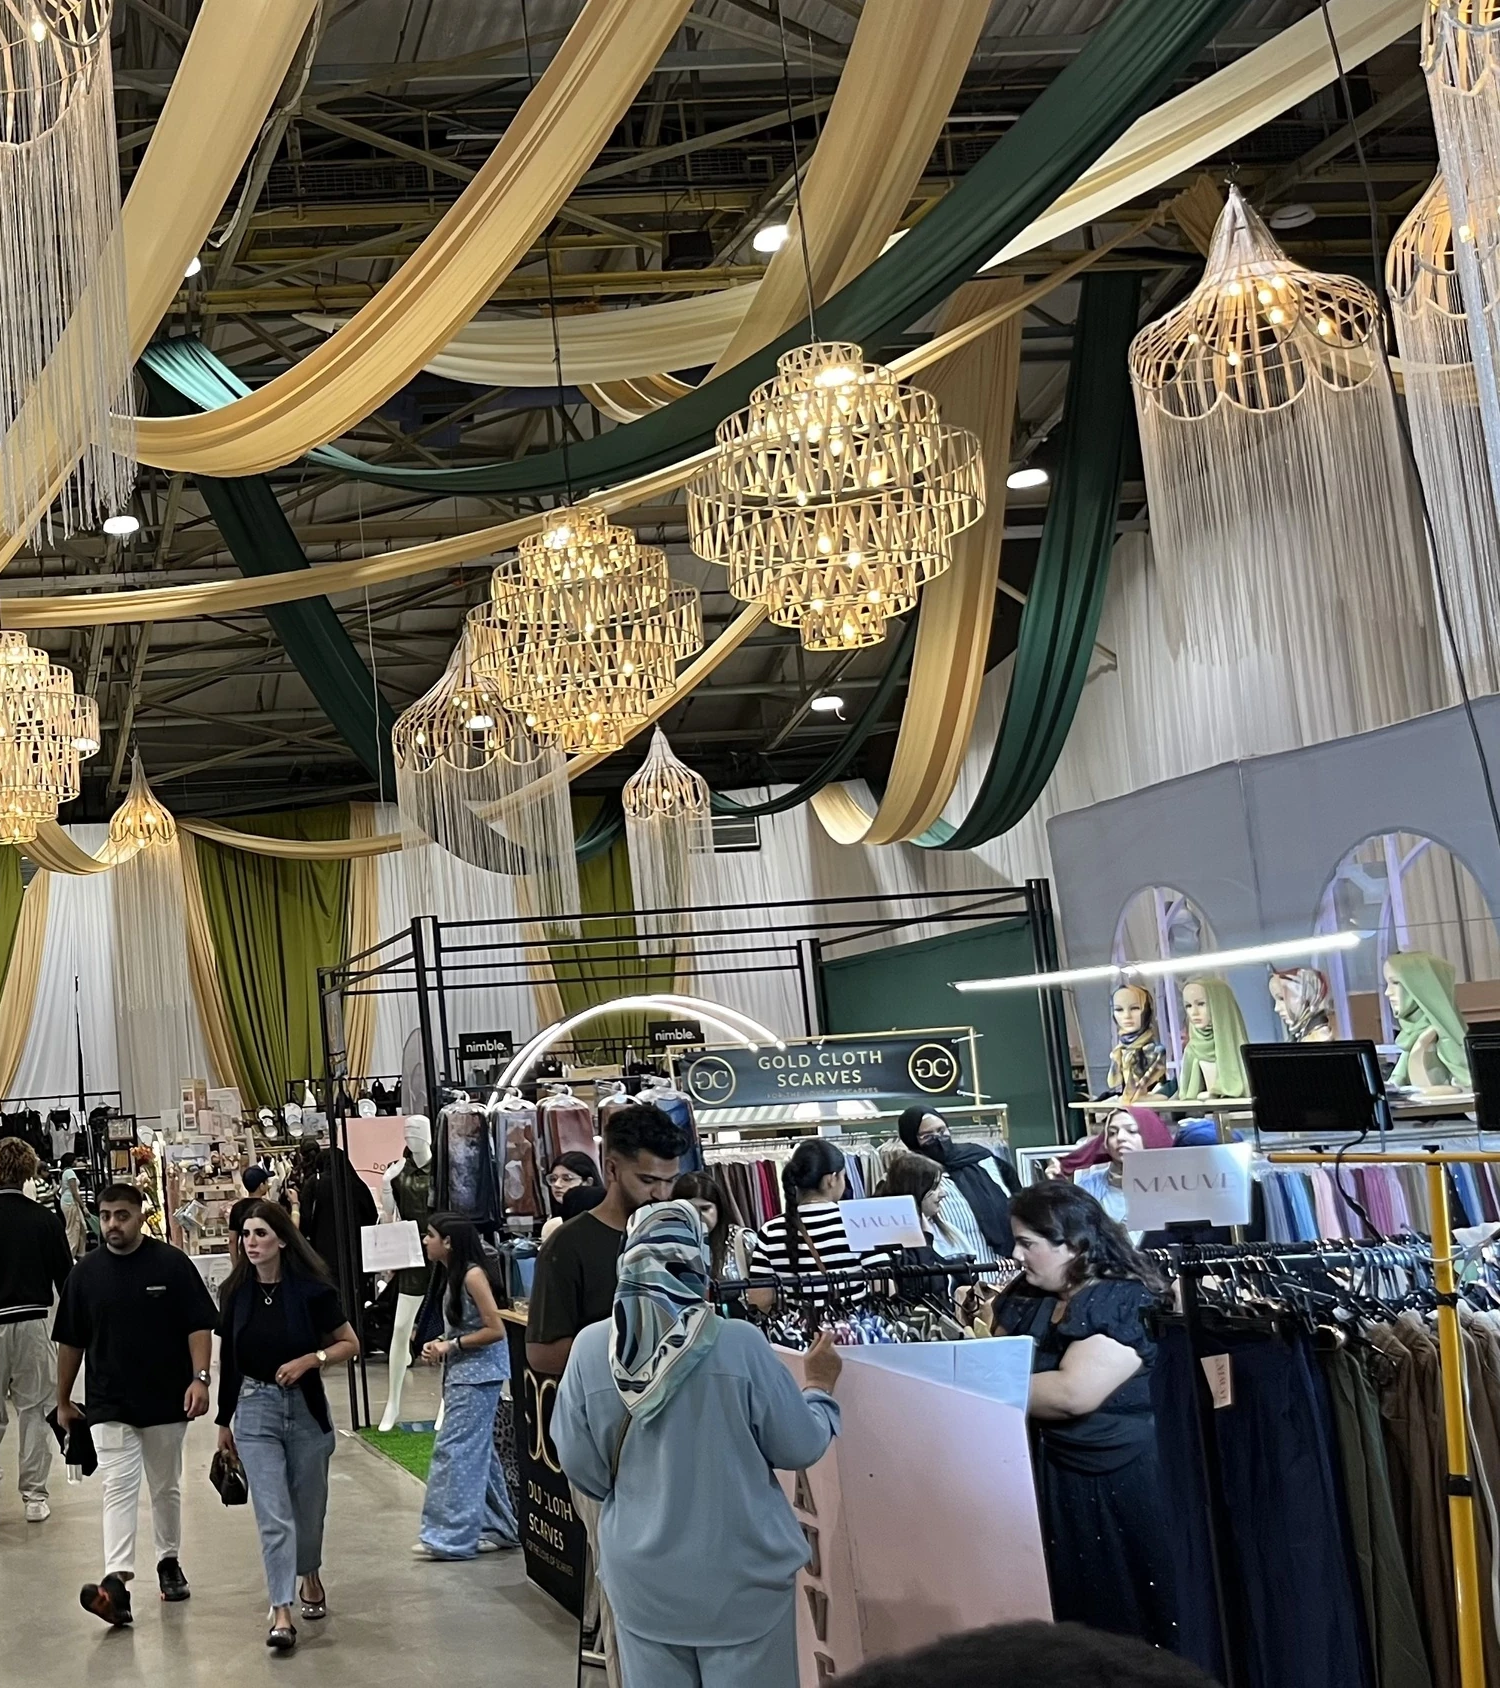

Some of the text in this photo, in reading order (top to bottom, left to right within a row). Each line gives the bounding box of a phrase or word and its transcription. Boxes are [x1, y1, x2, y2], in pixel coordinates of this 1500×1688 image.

[655, 1028, 696, 1041] nimble.
[465, 1040, 507, 1053] nimble.
[758, 1050, 883, 1070] GOLD CLOTH
[777, 1069, 862, 1088] SCARVES
[1132, 1172, 1238, 1193] MAUVE
[849, 1213, 915, 1229] MAUVE
